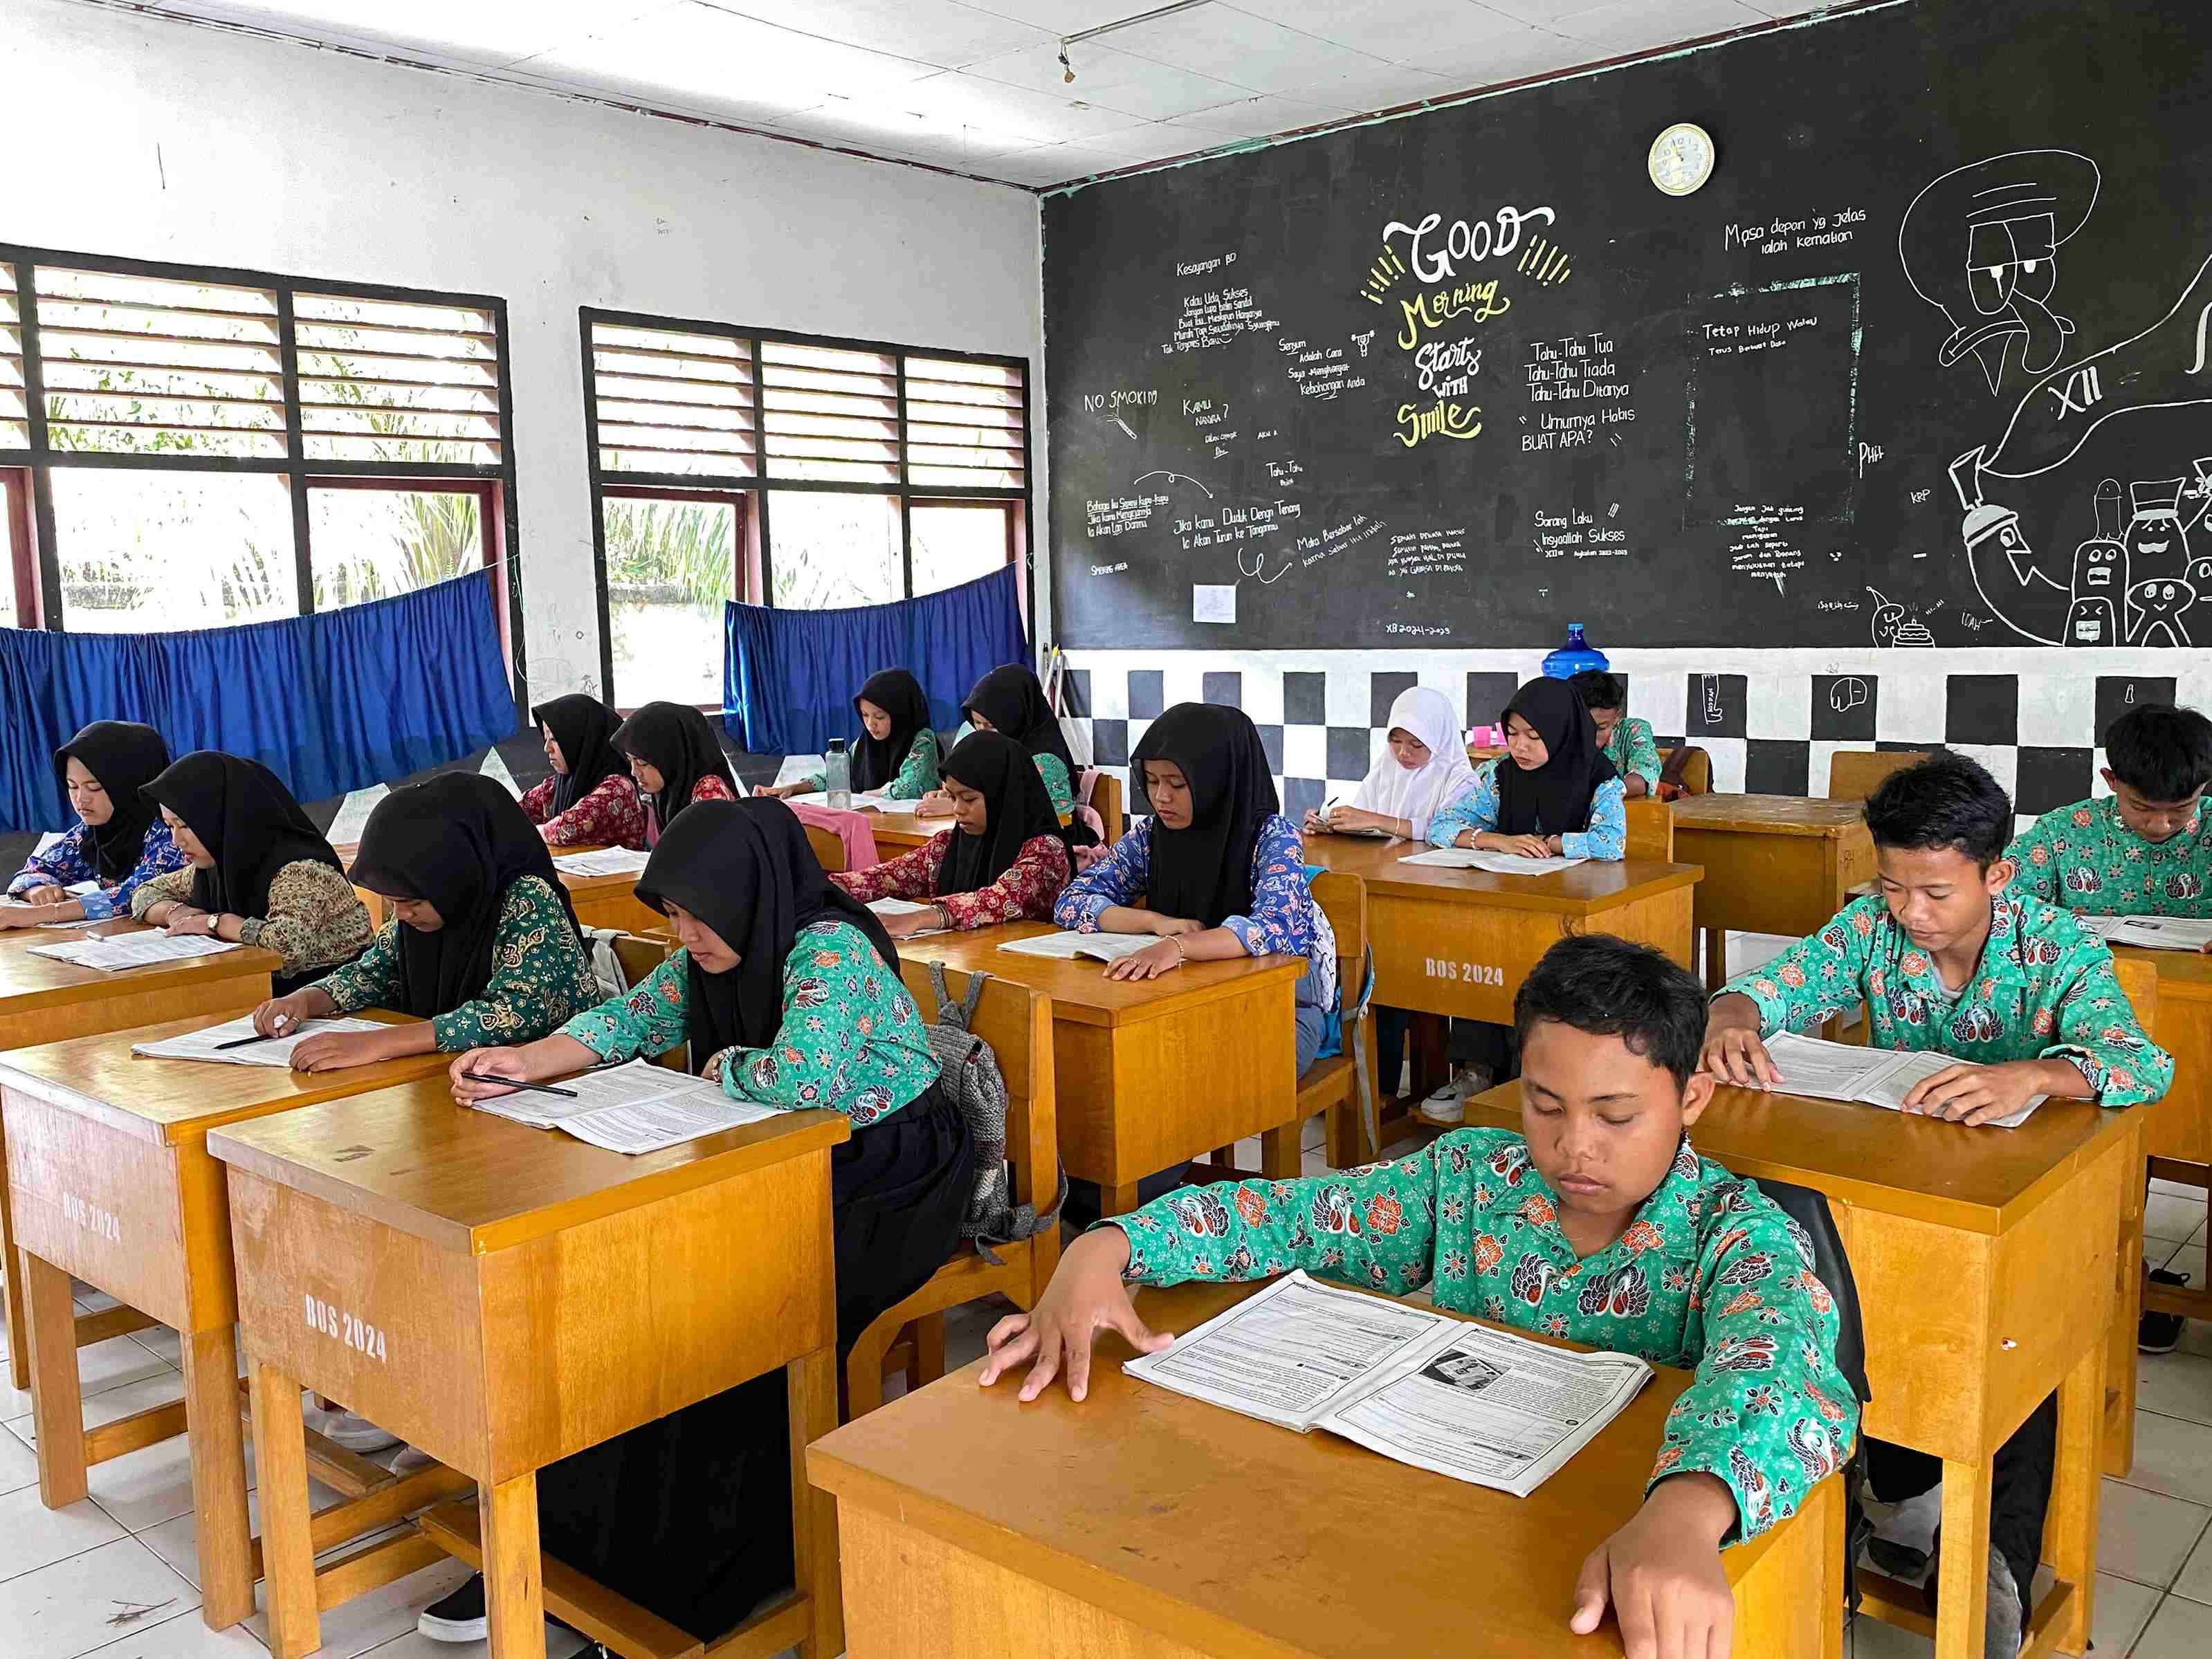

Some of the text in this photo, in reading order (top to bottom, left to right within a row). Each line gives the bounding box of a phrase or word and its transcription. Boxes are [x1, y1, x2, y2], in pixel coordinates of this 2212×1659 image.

[1725, 224, 1764, 251] Masa
[1771, 217, 1806, 236] depan
[1812, 217, 1826, 230] yg
[1383, 205, 1555, 284] GOOD
[1177, 258, 1221, 276] Kesayangan
[1398, 280, 1511, 350] Morning
[1702, 324, 1739, 340] Tetap
[1748, 322, 1781, 338] Hidup
[1588, 332, 1613, 354] Tua
[1299, 349, 1342, 363] Adalah Cara
[1288, 367, 1305, 382] Saya
[1579, 358, 1616, 377] Tiada
[1347, 376, 1366, 388] Anda
[1583, 380, 1629, 398] Ditanya
[2048, 366, 2102, 421] XII
[1084, 394, 1104, 412] NO
[1602, 407, 1636, 424] Habis
[1522, 432, 1557, 451] BUAT
[1589, 527, 1625, 543] Sukses
[1426, 957, 1503, 986] BOS 2024
[305, 1294, 387, 1363] BOS 2024
